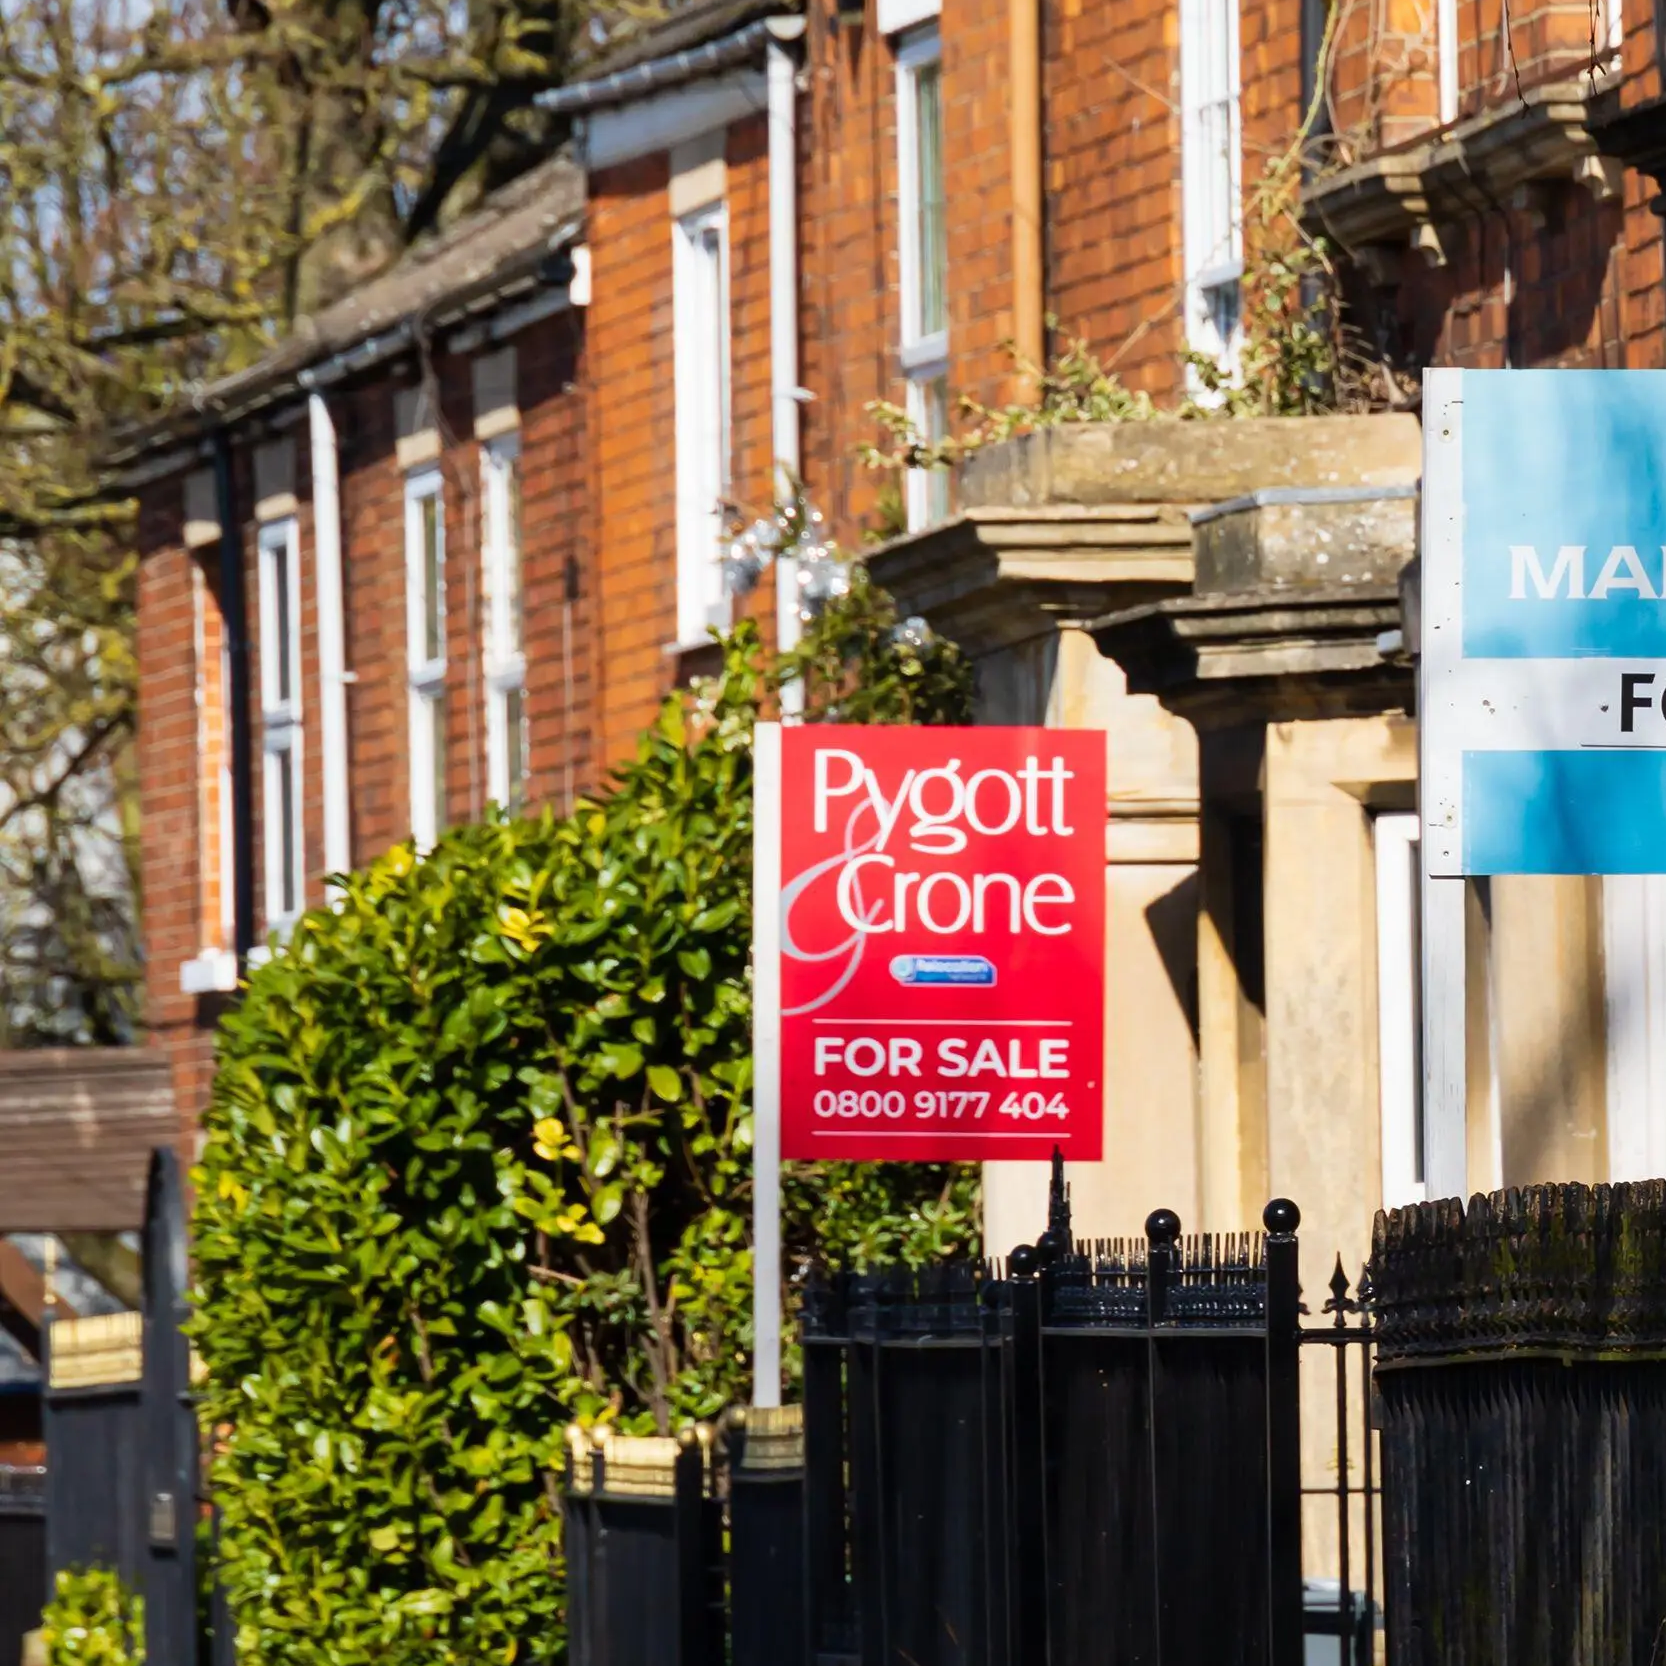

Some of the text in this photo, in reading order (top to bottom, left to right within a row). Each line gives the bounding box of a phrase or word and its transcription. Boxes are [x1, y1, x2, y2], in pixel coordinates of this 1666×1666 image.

[813, 748, 1075, 855] Pygott
[837, 853, 1076, 936] Crone
[814, 1037, 1070, 1079] FOR SALE
[813, 1089, 1070, 1120] 0800 9177 404
